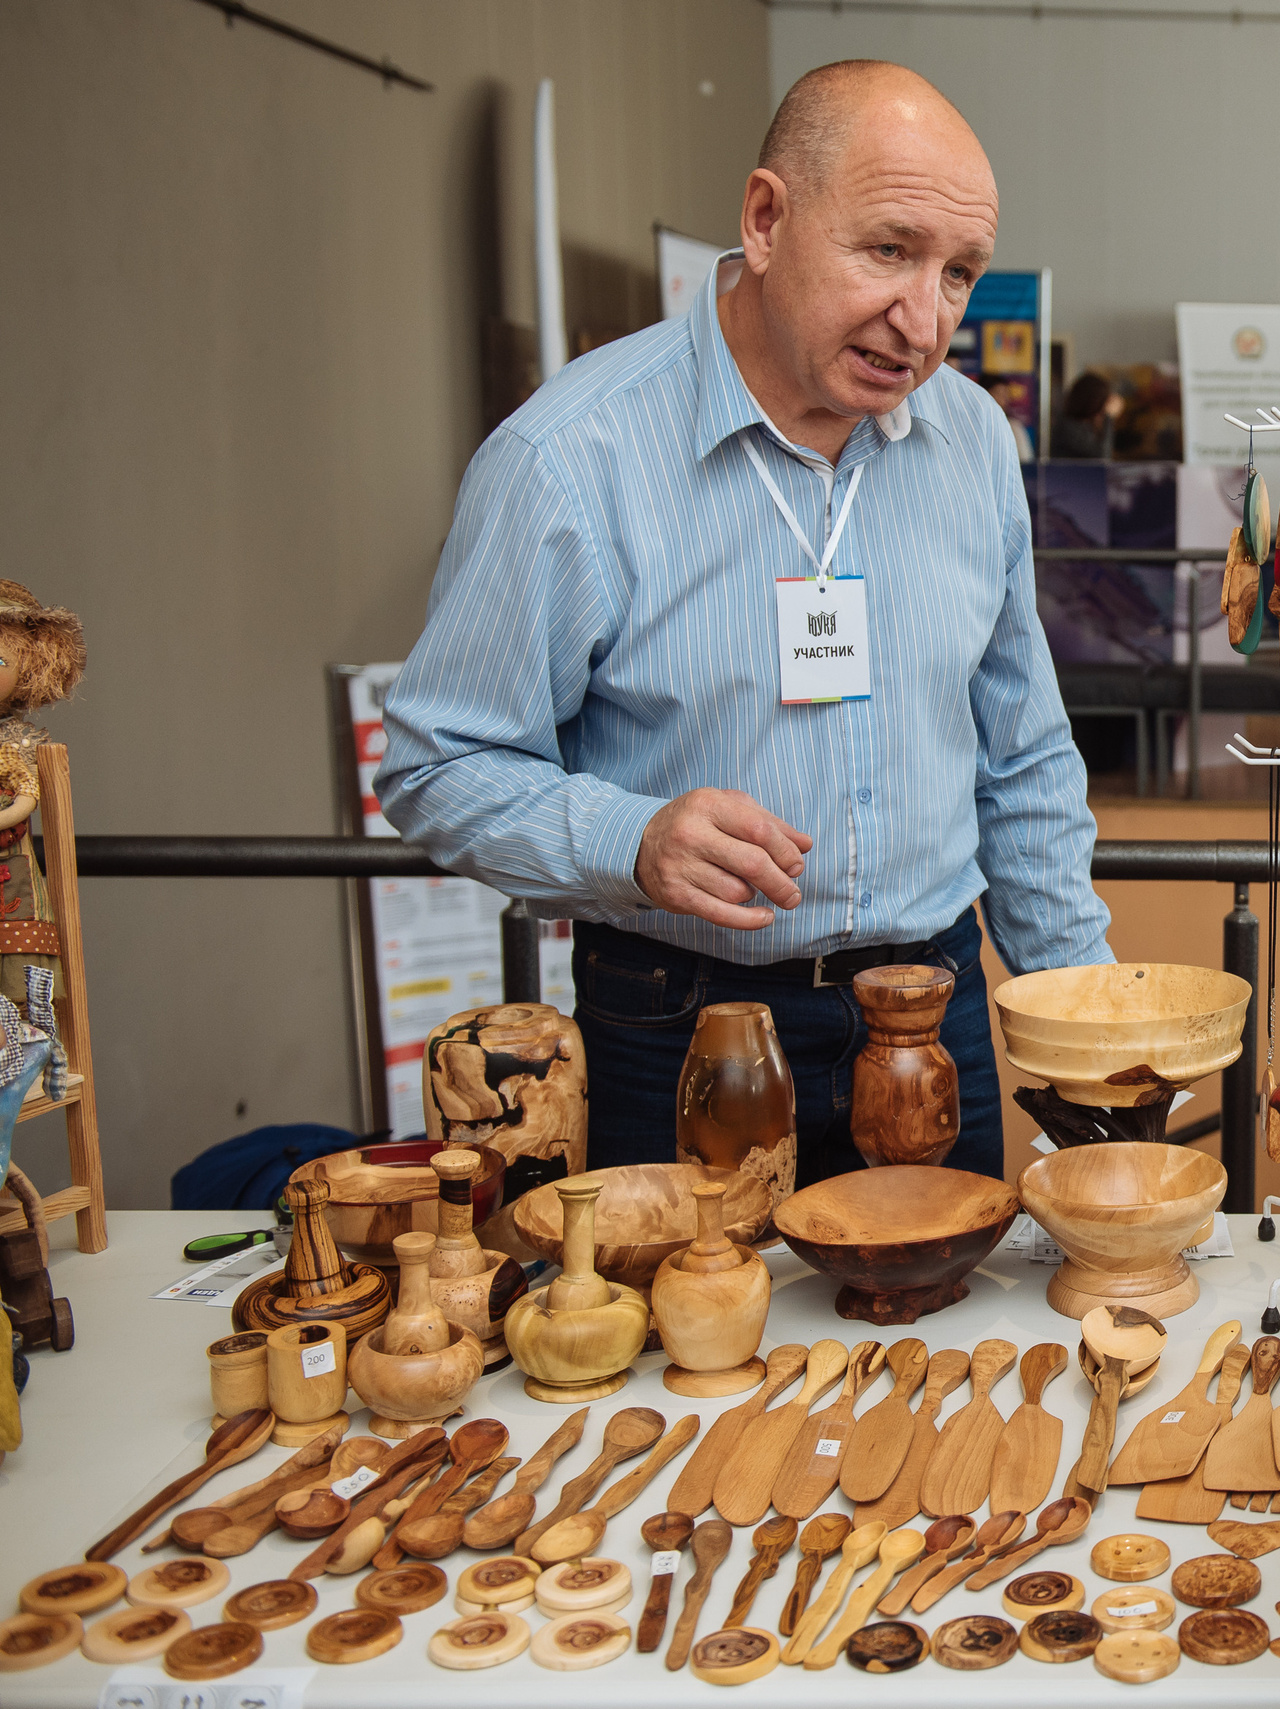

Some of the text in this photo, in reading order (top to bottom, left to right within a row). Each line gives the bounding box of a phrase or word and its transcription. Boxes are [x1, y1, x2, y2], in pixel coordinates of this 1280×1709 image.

[793, 645, 855, 660] УЧАСТНИК
[307, 1353, 325, 1366] 200
[819, 1442, 832, 1454] 500
[341, 1472, 370, 1494] 350
[1117, 1607, 1142, 1617] 100
